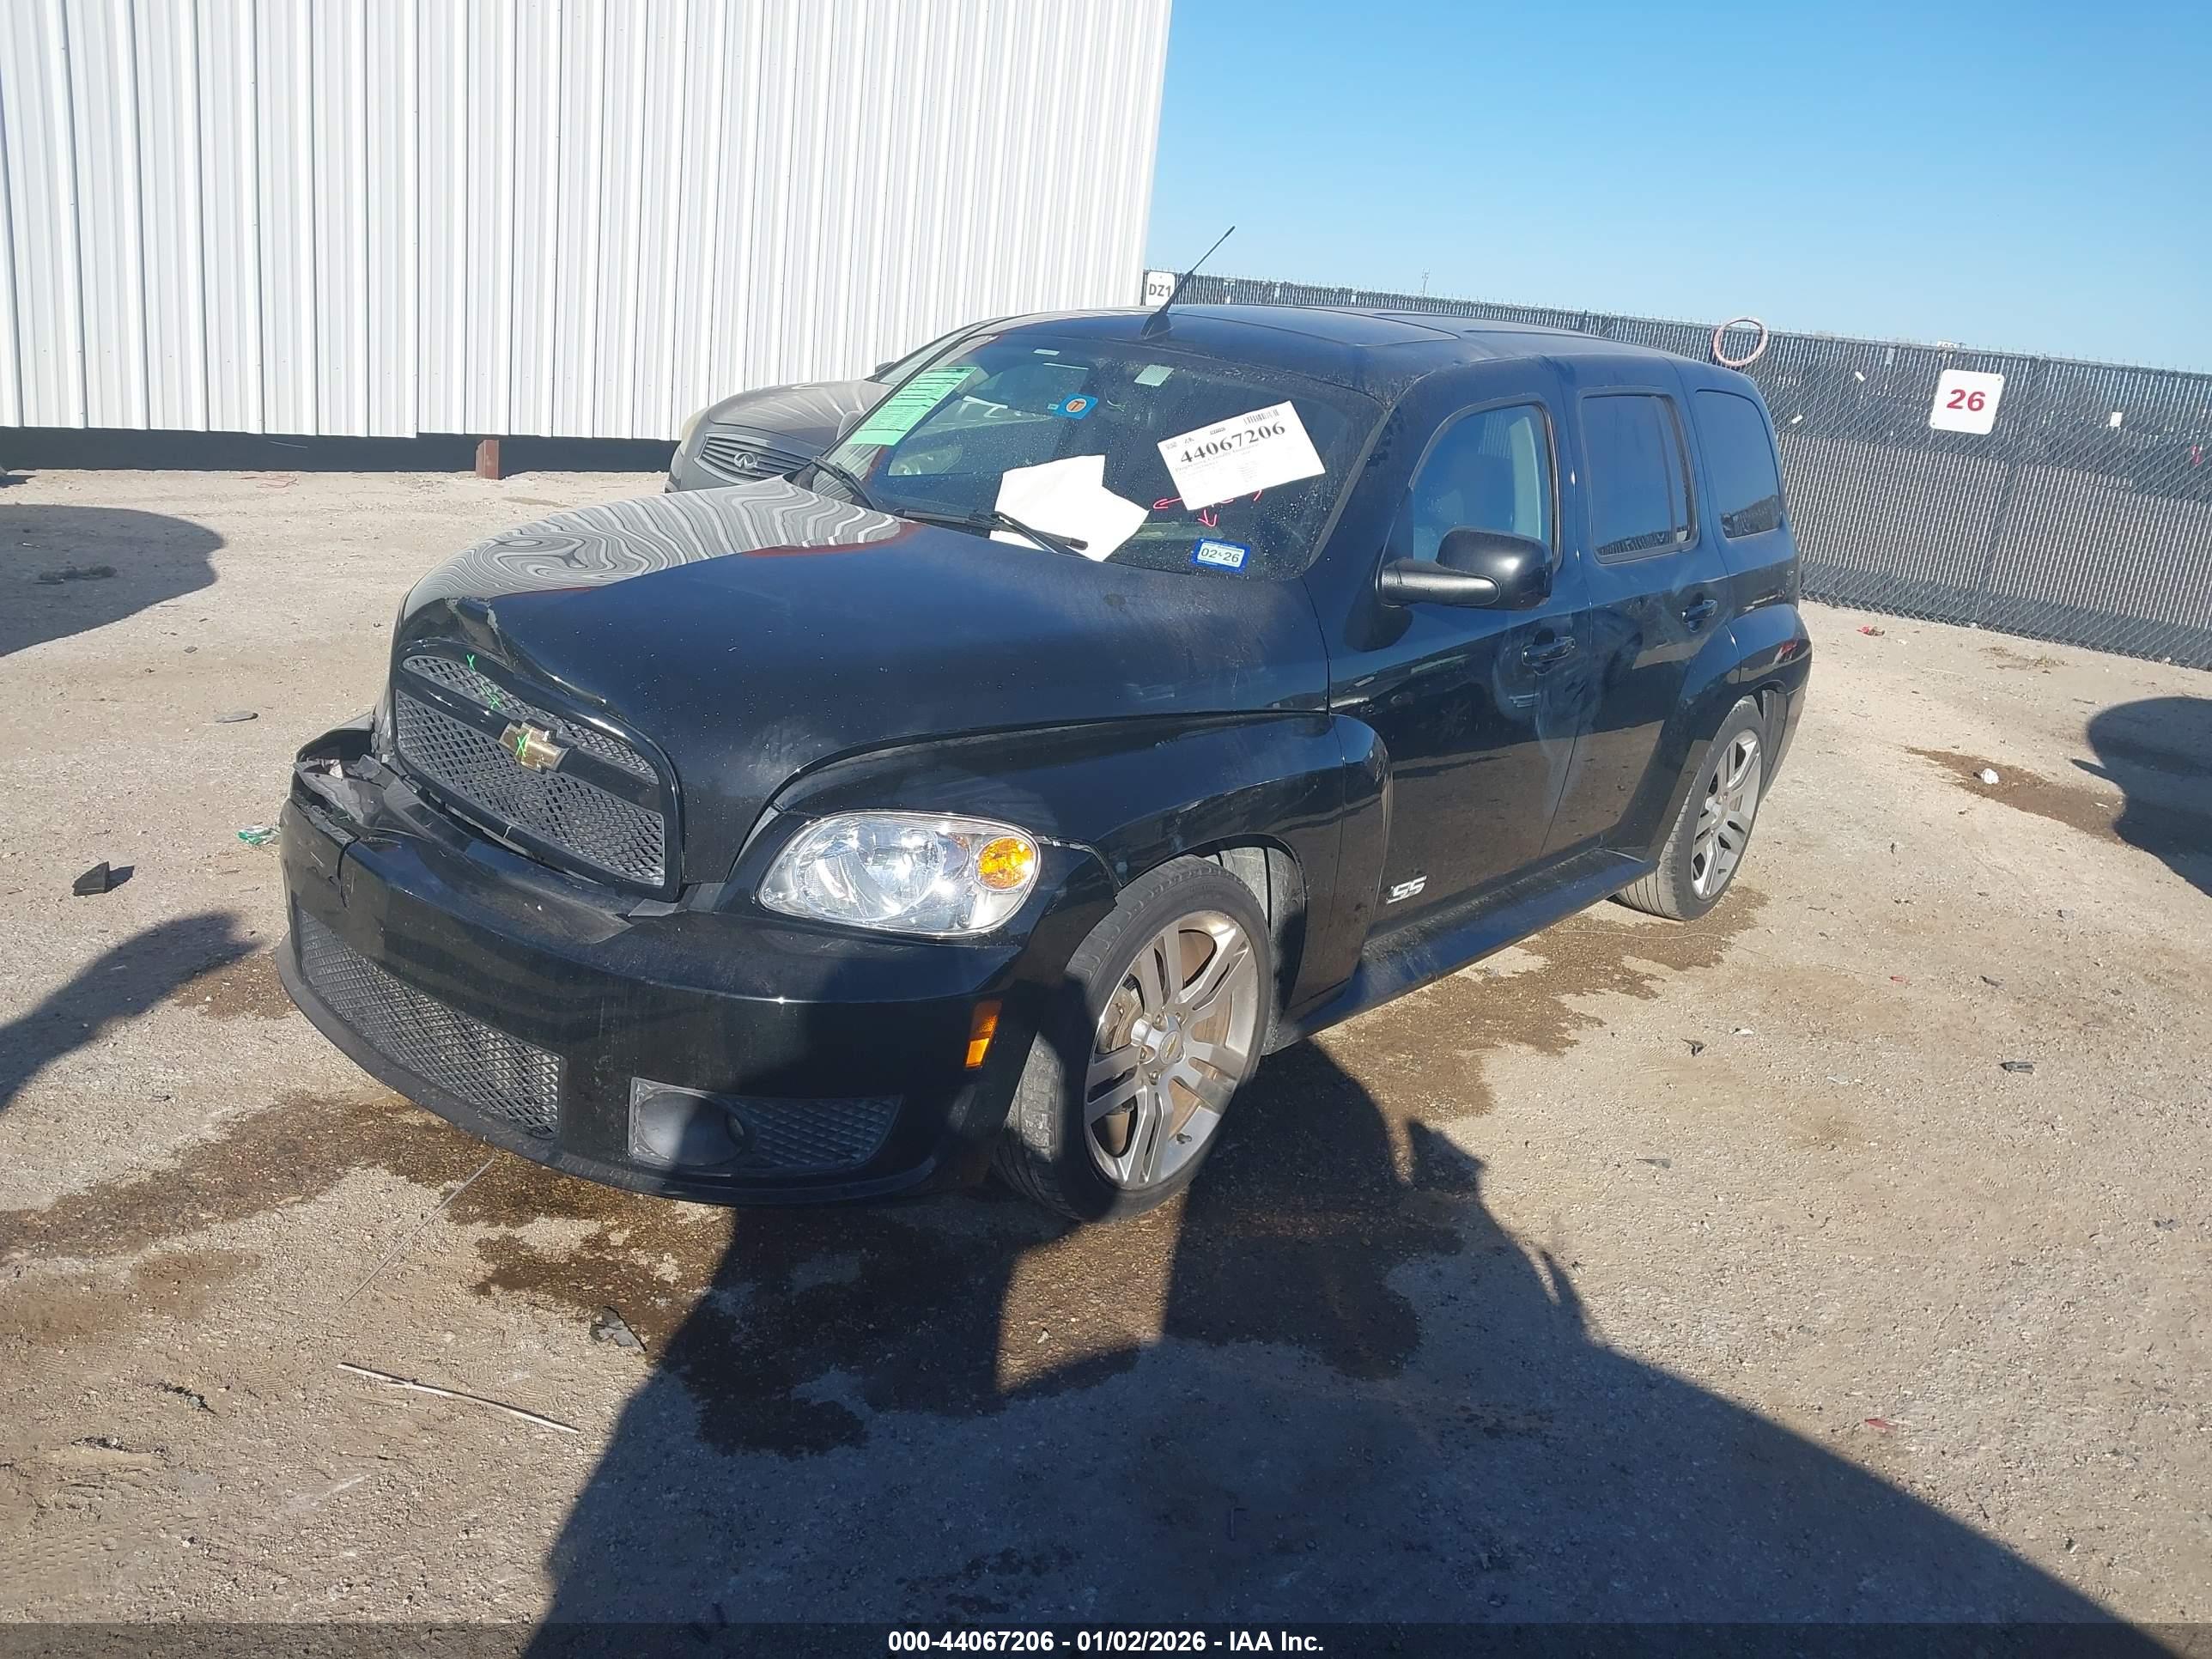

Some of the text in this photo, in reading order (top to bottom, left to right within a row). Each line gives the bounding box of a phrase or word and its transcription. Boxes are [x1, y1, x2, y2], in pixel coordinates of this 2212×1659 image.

[1148, 283, 1171, 297] DZ1
[1946, 389, 1986, 412] 26
[1180, 421, 1286, 464] 44067206
[1386, 875, 1427, 904] SS
